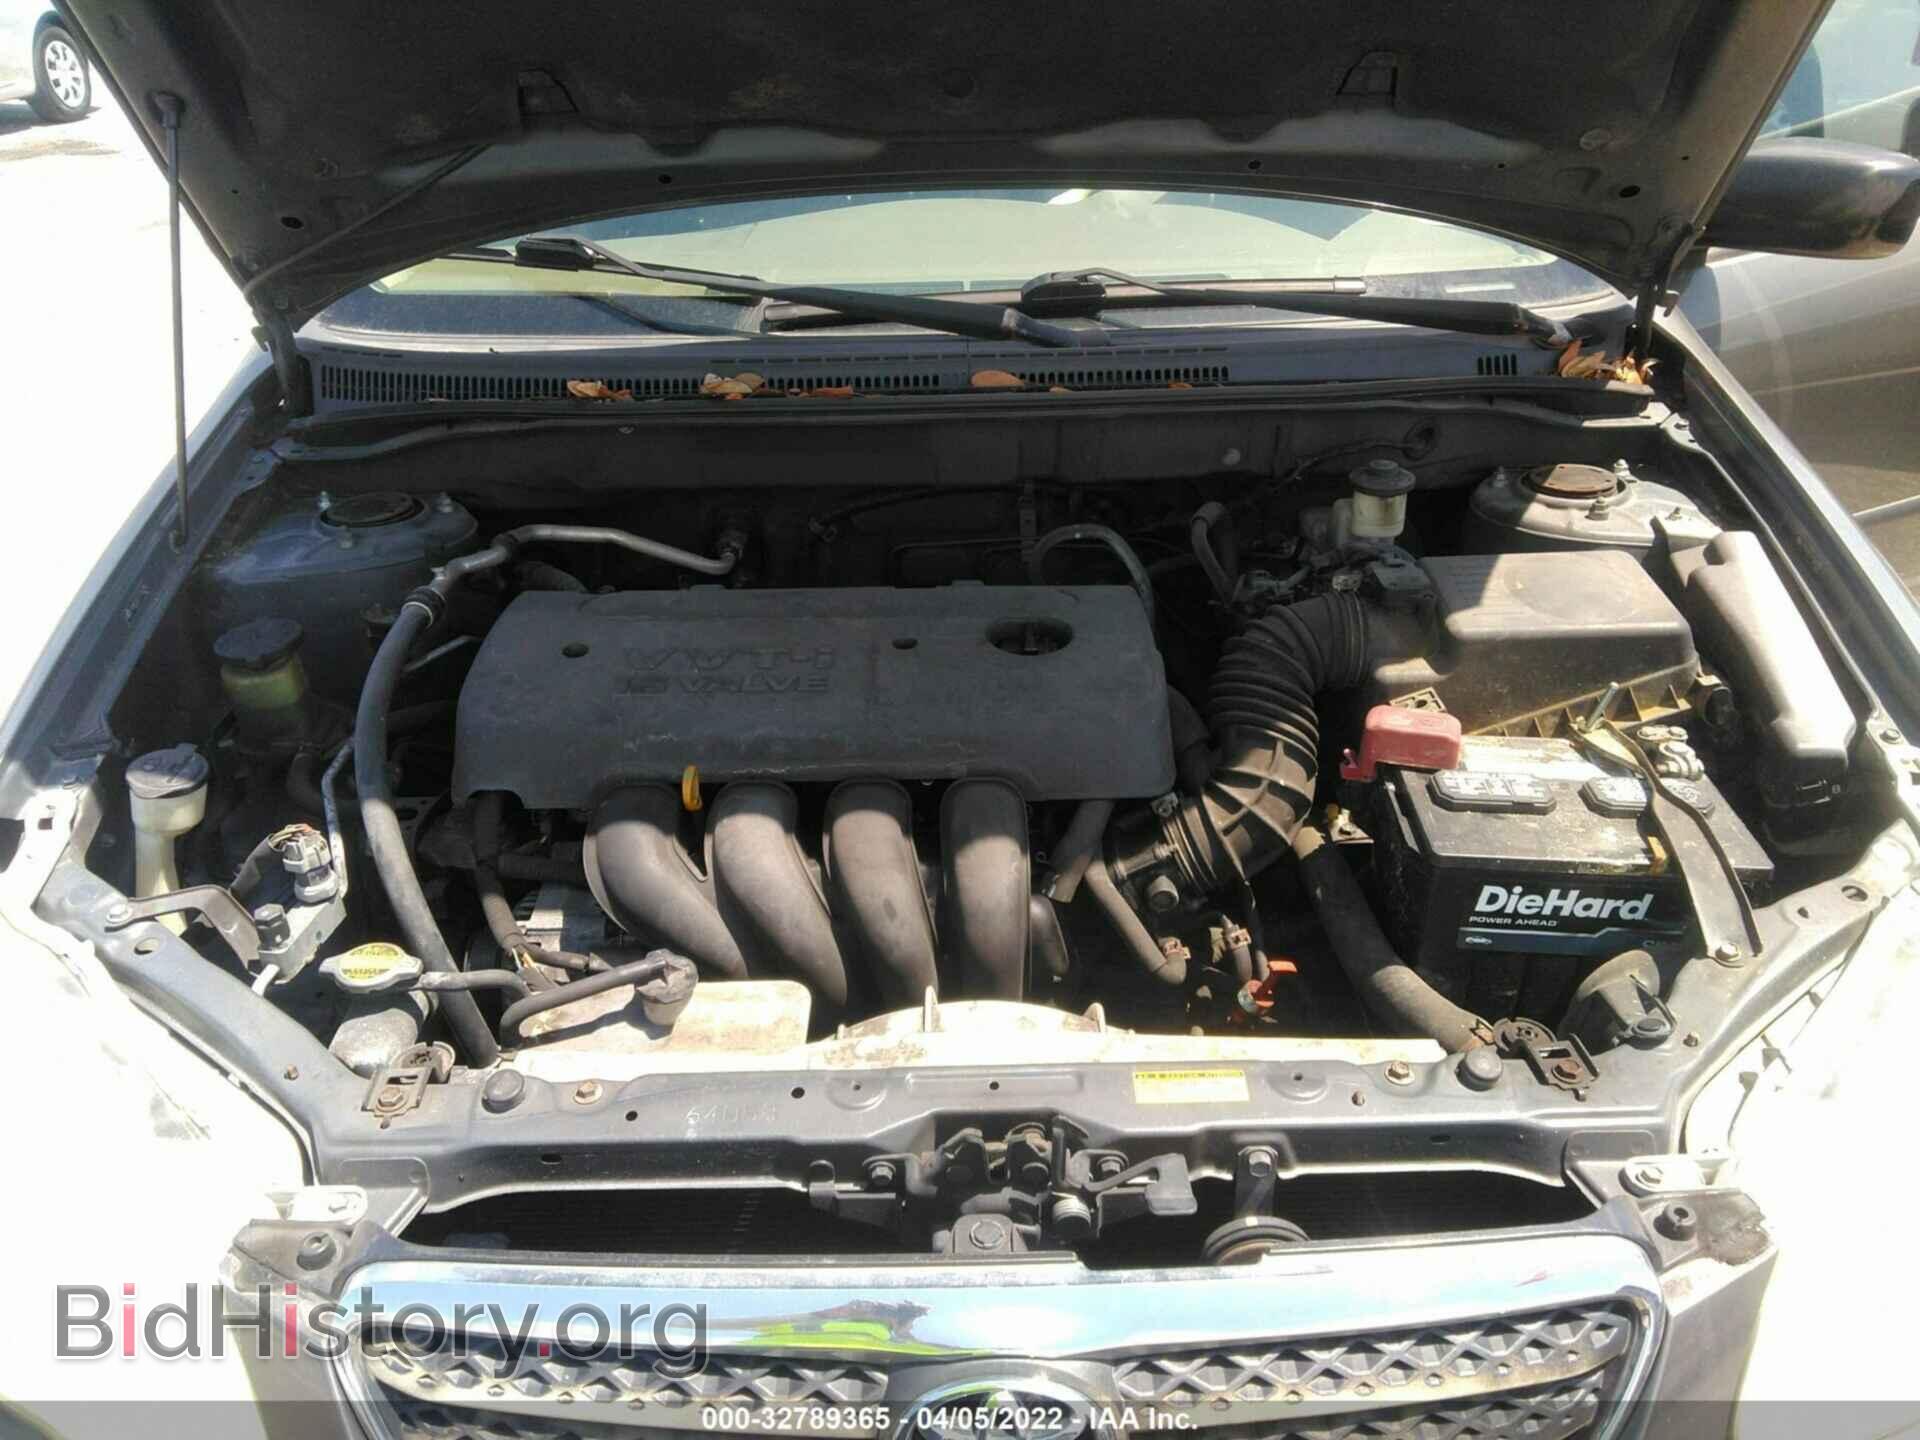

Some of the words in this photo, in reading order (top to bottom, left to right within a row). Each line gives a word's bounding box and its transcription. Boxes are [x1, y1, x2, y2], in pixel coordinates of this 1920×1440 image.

[1474, 885, 1654, 920] DieHard
[1469, 915, 1512, 925] POWER
[1515, 918, 1557, 927] AHEAD
